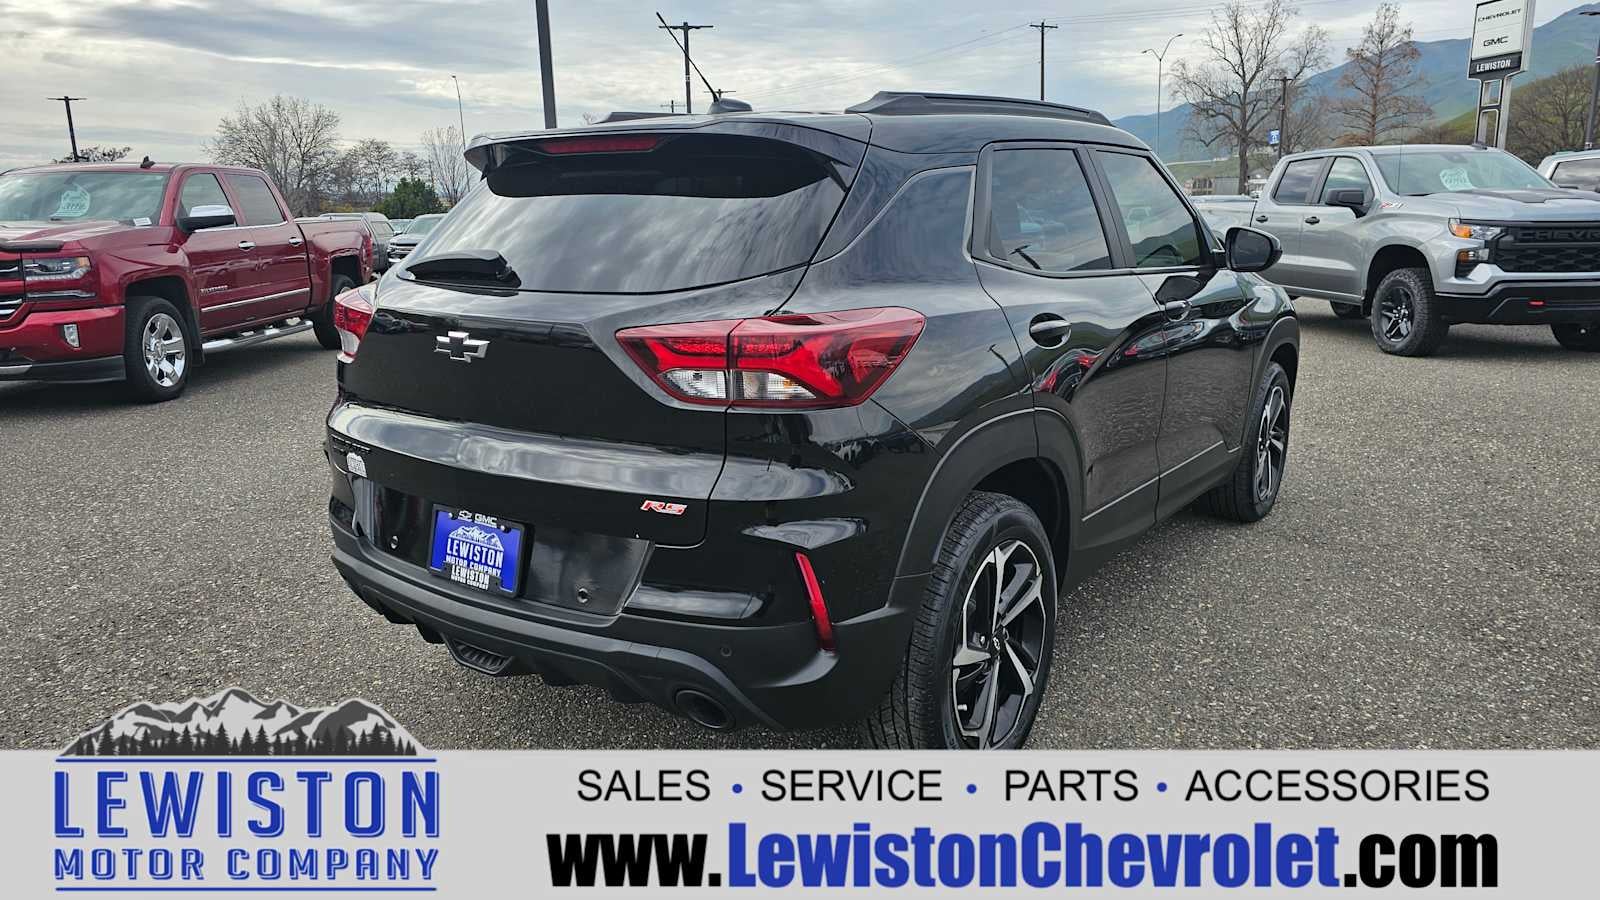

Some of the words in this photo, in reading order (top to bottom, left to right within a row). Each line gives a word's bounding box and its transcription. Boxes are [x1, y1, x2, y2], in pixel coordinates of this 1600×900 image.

[1477, 8, 1521, 22] CHEVROLET
[1483, 36, 1509, 47] GMC
[1476, 59, 1512, 73] LEWISTON
[640, 500, 688, 516] RS
[474, 513, 498, 525] GMC
[446, 538, 504, 569] LEWISTON
[445, 555, 468, 567] MOTOR
[469, 561, 502, 577] COMPANY
[450, 574, 467, 584] MOTOR
[466, 579, 489, 590] COMPANY
[451, 564, 490, 585] LEWISTON
